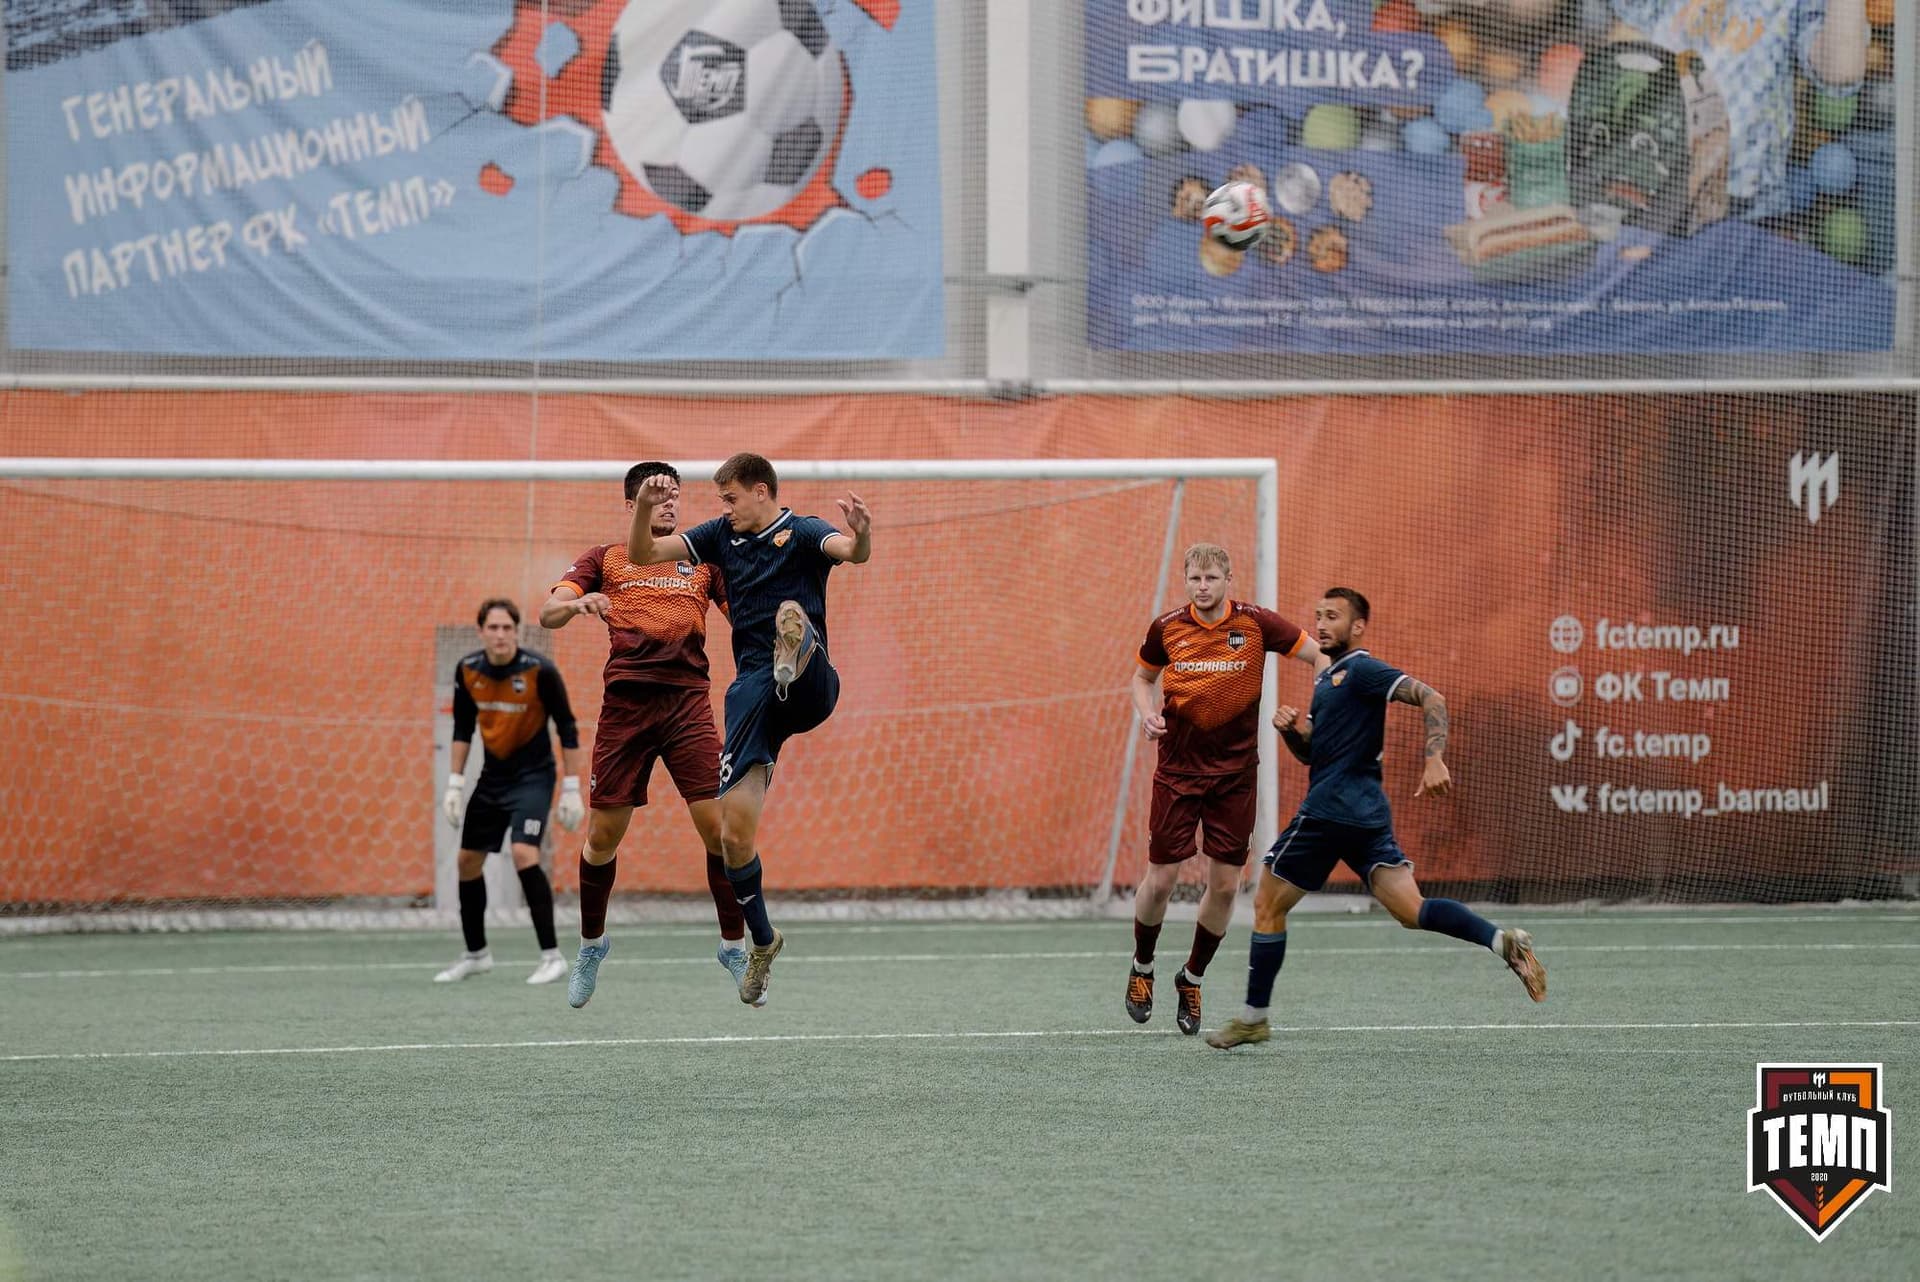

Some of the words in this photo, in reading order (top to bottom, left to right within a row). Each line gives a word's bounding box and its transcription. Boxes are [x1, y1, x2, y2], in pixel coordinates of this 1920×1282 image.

[1127, 0, 1347, 40] ФИШКА,
[1127, 45, 1425, 89] БРАТИШКА?
[62, 38, 333, 142] ГЕНЕРАЛЬНЫЙ
[65, 94, 431, 224] ИНФОРМАЦИОННЫЙ
[63, 221, 232, 298] ПАРТНЕР
[242, 204, 307, 256] ФК
[1596, 618, 1740, 656] fctemp.ru
[1174, 661, 1247, 673] ПРОДИНВЕСТ
[1595, 672, 1643, 701] ФК
[1651, 672, 1730, 701] Темп
[1595, 727, 1711, 764] fc.temp
[1599, 781, 1829, 818] fctemp_barnaul
